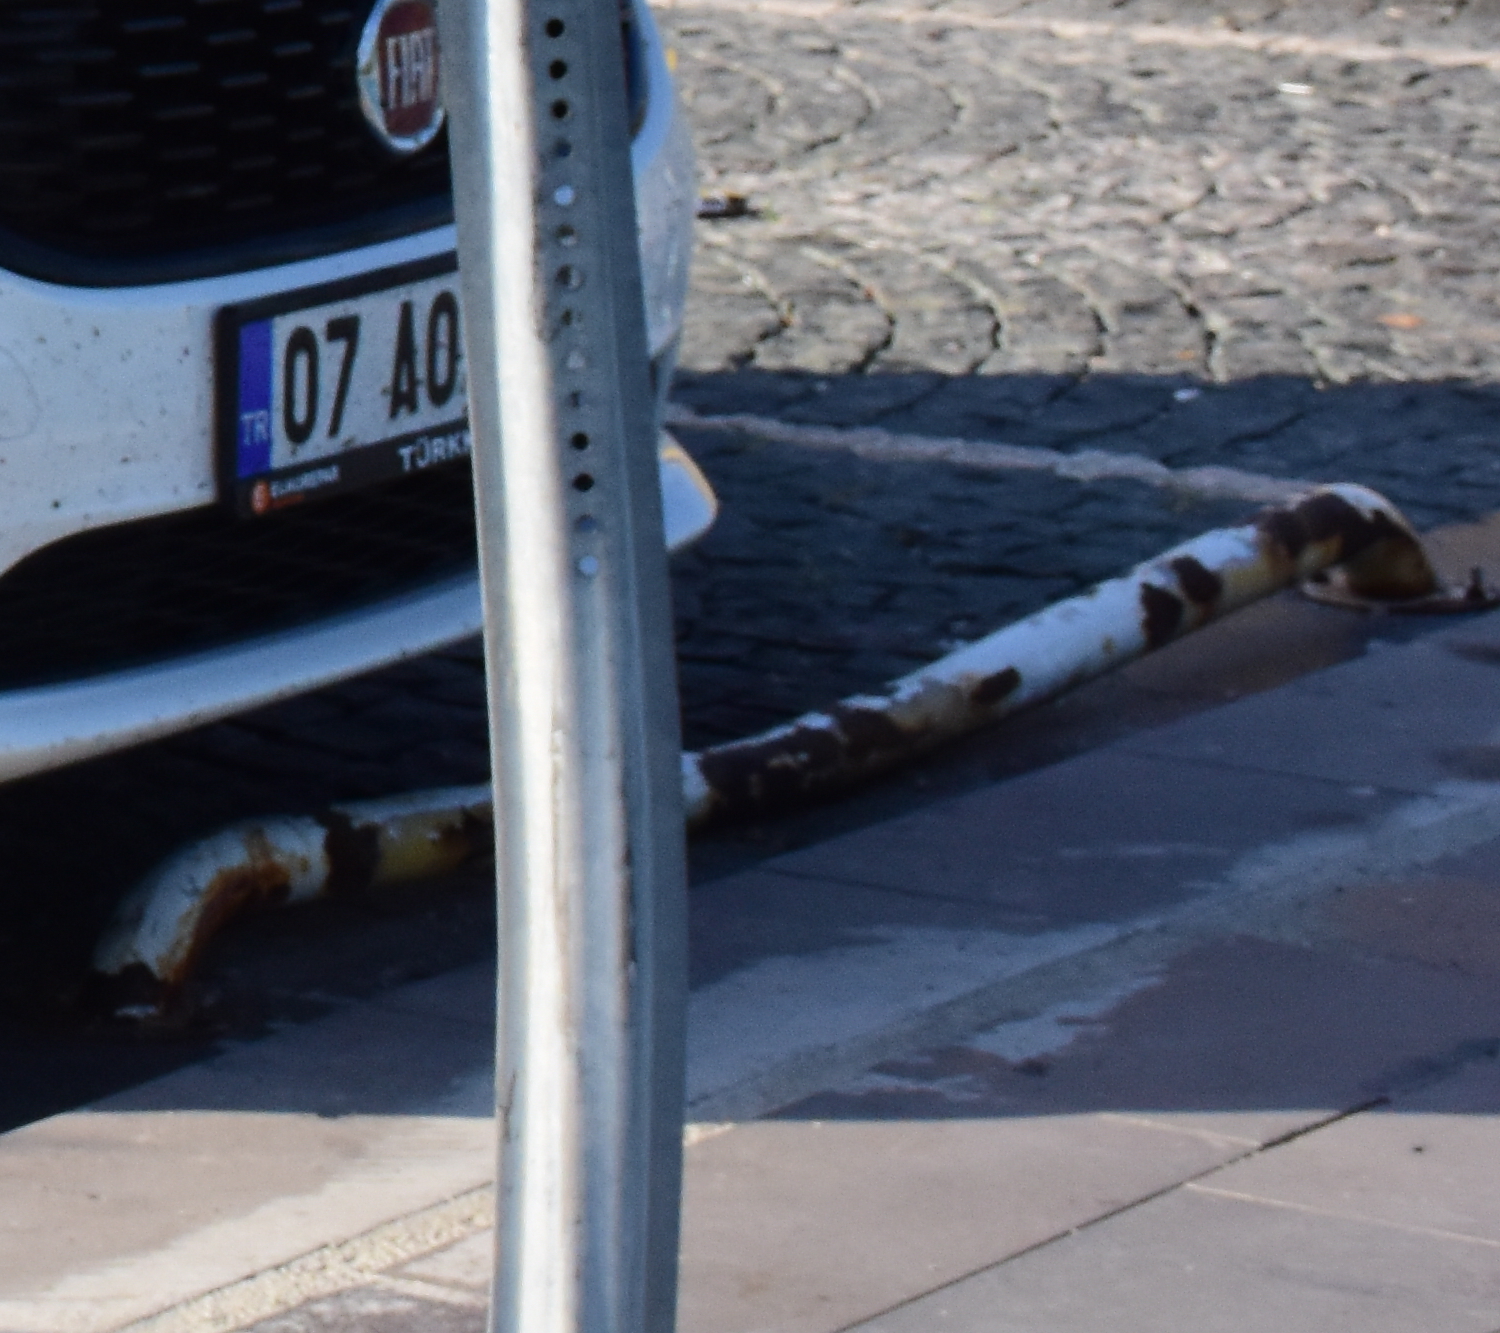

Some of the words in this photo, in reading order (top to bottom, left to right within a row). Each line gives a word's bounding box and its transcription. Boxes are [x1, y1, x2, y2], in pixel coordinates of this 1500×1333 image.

[386, 26, 435, 111] FIAT
[240, 409, 269, 446] TR
[284, 314, 361, 445] 07
